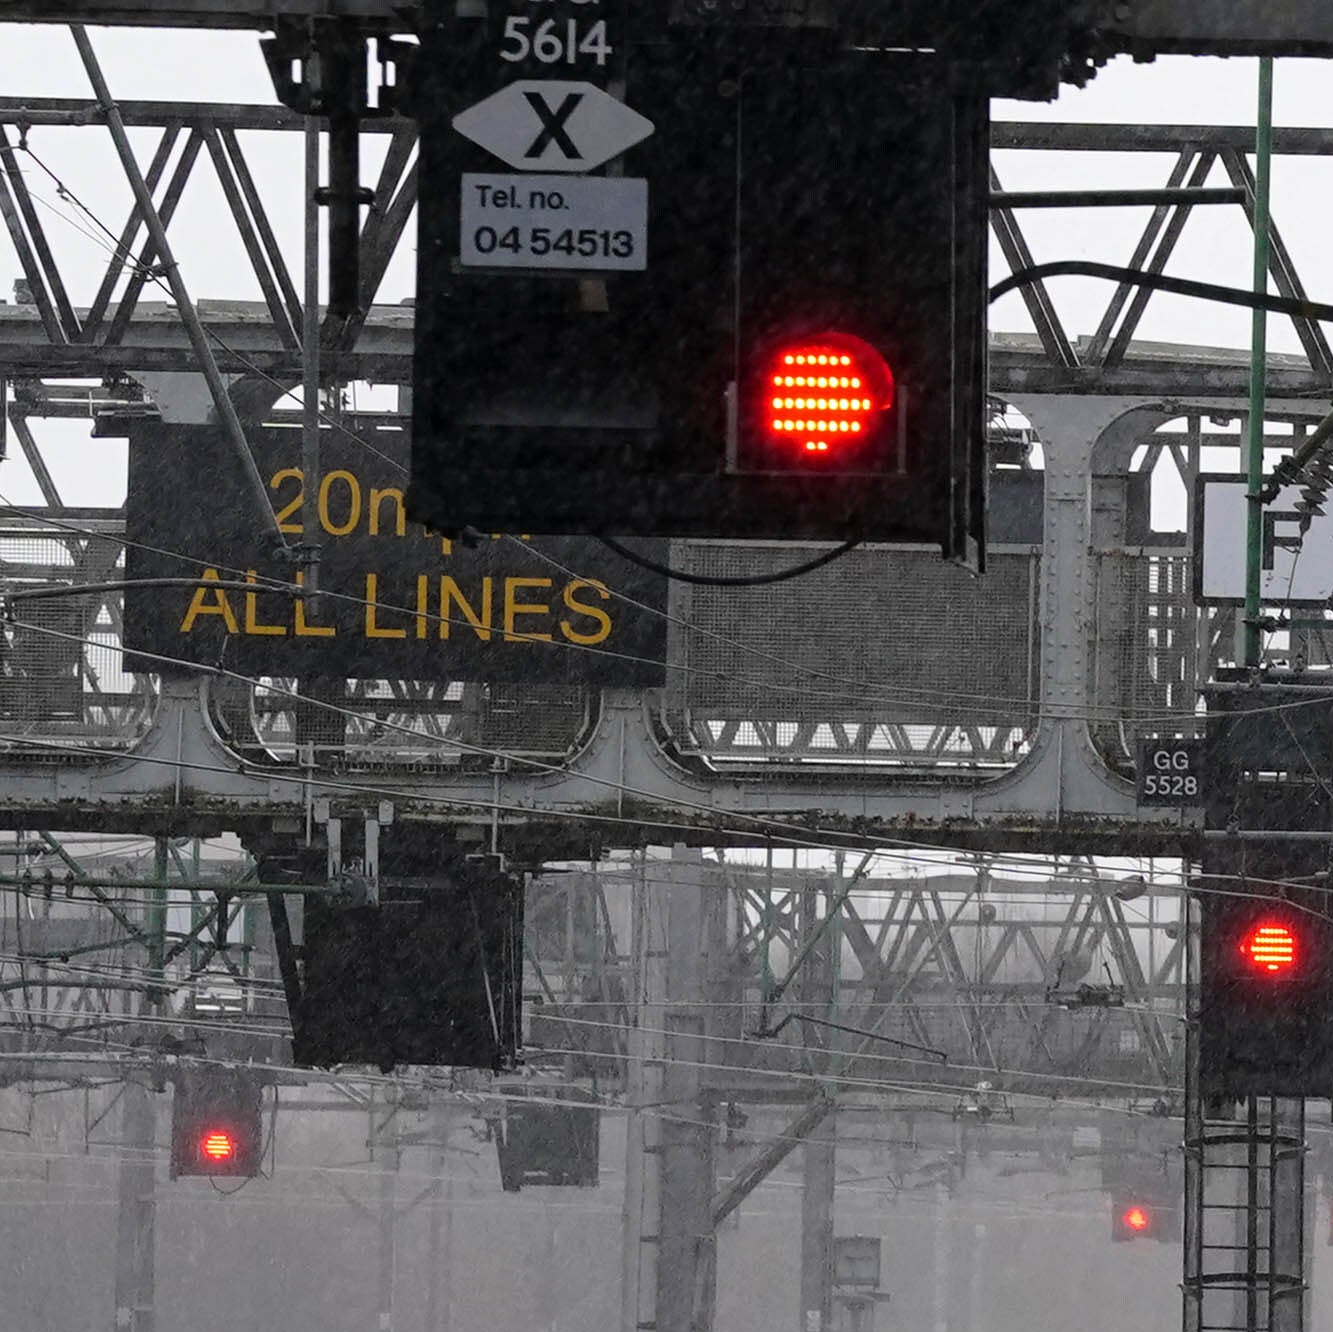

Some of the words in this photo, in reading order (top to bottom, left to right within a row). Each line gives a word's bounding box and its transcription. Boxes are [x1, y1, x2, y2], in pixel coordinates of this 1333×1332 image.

[500, 15, 613, 66] 5614
[522, 91, 585, 160] X
[475, 184, 521, 209] Tel.
[529, 191, 570, 210] no.
[474, 226, 522, 254] 04
[529, 228, 635, 258] 54513
[1261, 510, 1302, 570] F
[179, 567, 337, 636] ALL
[364, 572, 614, 646] LINES
[1153, 750, 1189, 770] GG
[1144, 775, 1198, 796] 5528
